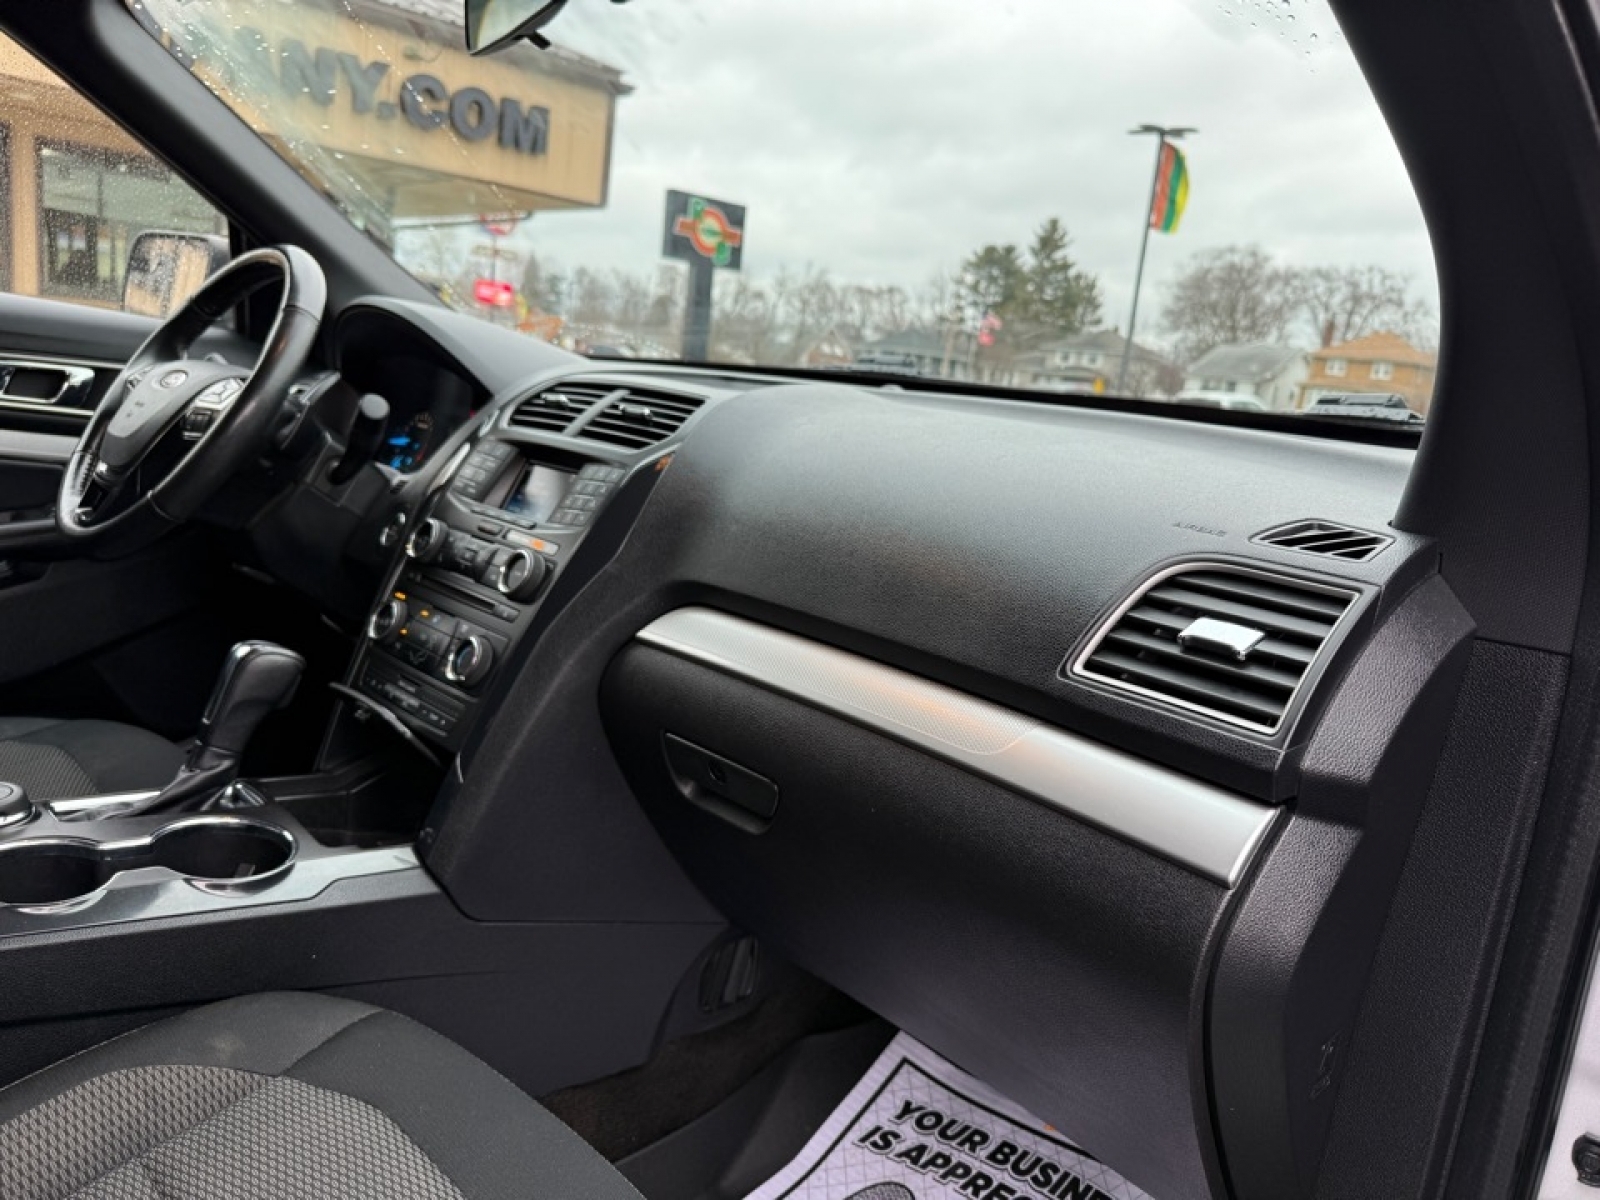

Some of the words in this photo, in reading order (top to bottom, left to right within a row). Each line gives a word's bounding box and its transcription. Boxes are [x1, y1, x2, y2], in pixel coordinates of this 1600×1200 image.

[894, 1099, 991, 1154] YOUR
[857, 1124, 902, 1151] IS
[893, 1143, 1033, 1200] APPRE
